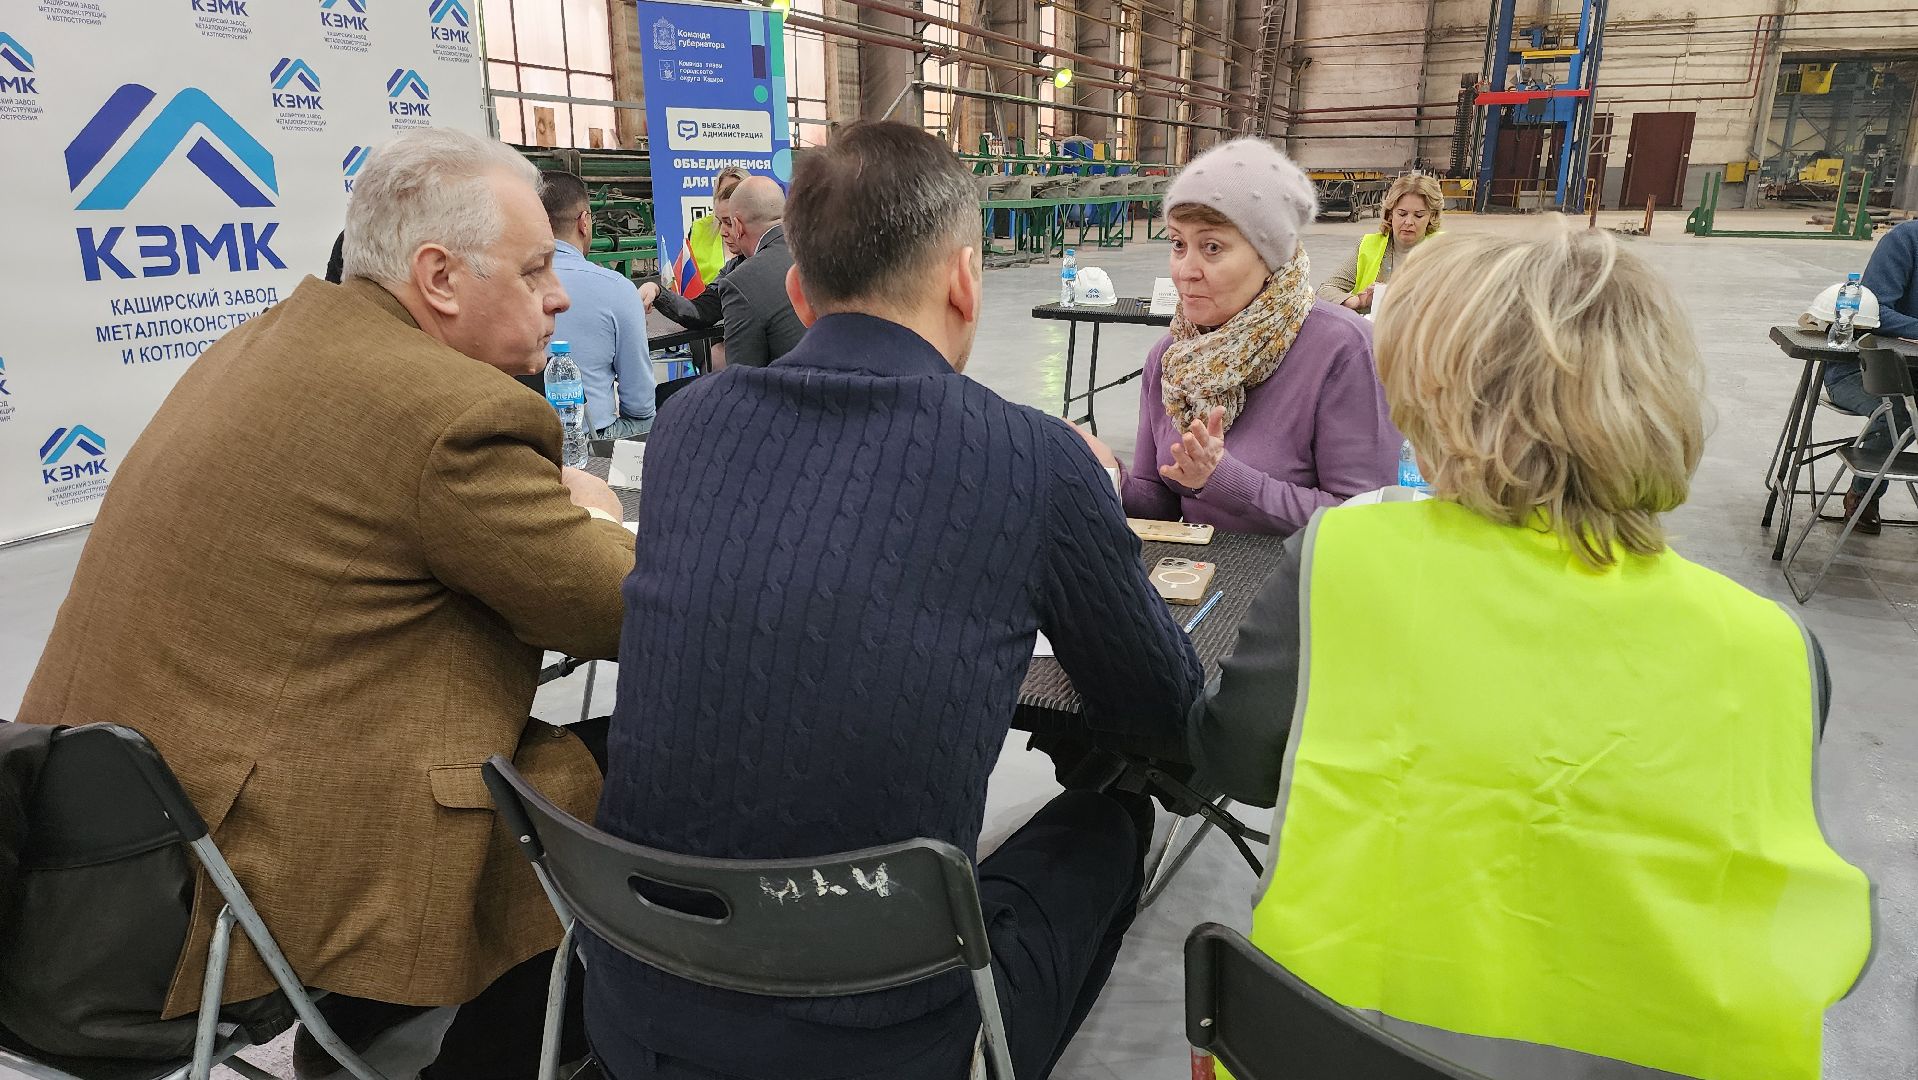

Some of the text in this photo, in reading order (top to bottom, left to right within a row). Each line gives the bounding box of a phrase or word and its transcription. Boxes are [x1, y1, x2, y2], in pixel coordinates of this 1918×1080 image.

[191, 0, 249, 17] КЗМК
[321, 12, 370, 31] КЗМК
[431, 26, 471, 44] КЗМК
[678, 29, 711, 39] Команда
[679, 40, 726, 50] губернатора
[679, 60, 703, 68] Команда
[0, 75, 39, 94] МК
[272, 93, 324, 110] КЗМК
[389, 101, 431, 117] КЗМК
[702, 131, 764, 139] АДМИНИСТРАЦИЯ
[673, 158, 771, 171] ОБЪЕДИНЯЕМСЯ
[683, 176, 709, 188] ДЛЯ
[76, 222, 288, 281] КЗМК
[111, 287, 279, 316] КАШИРСКИЙ ЗАВОД
[96, 312, 260, 342] МЕТАЛЛОКОНСТР
[122, 339, 216, 365] И КОТЛОС
[43, 458, 109, 484] КЗМК
